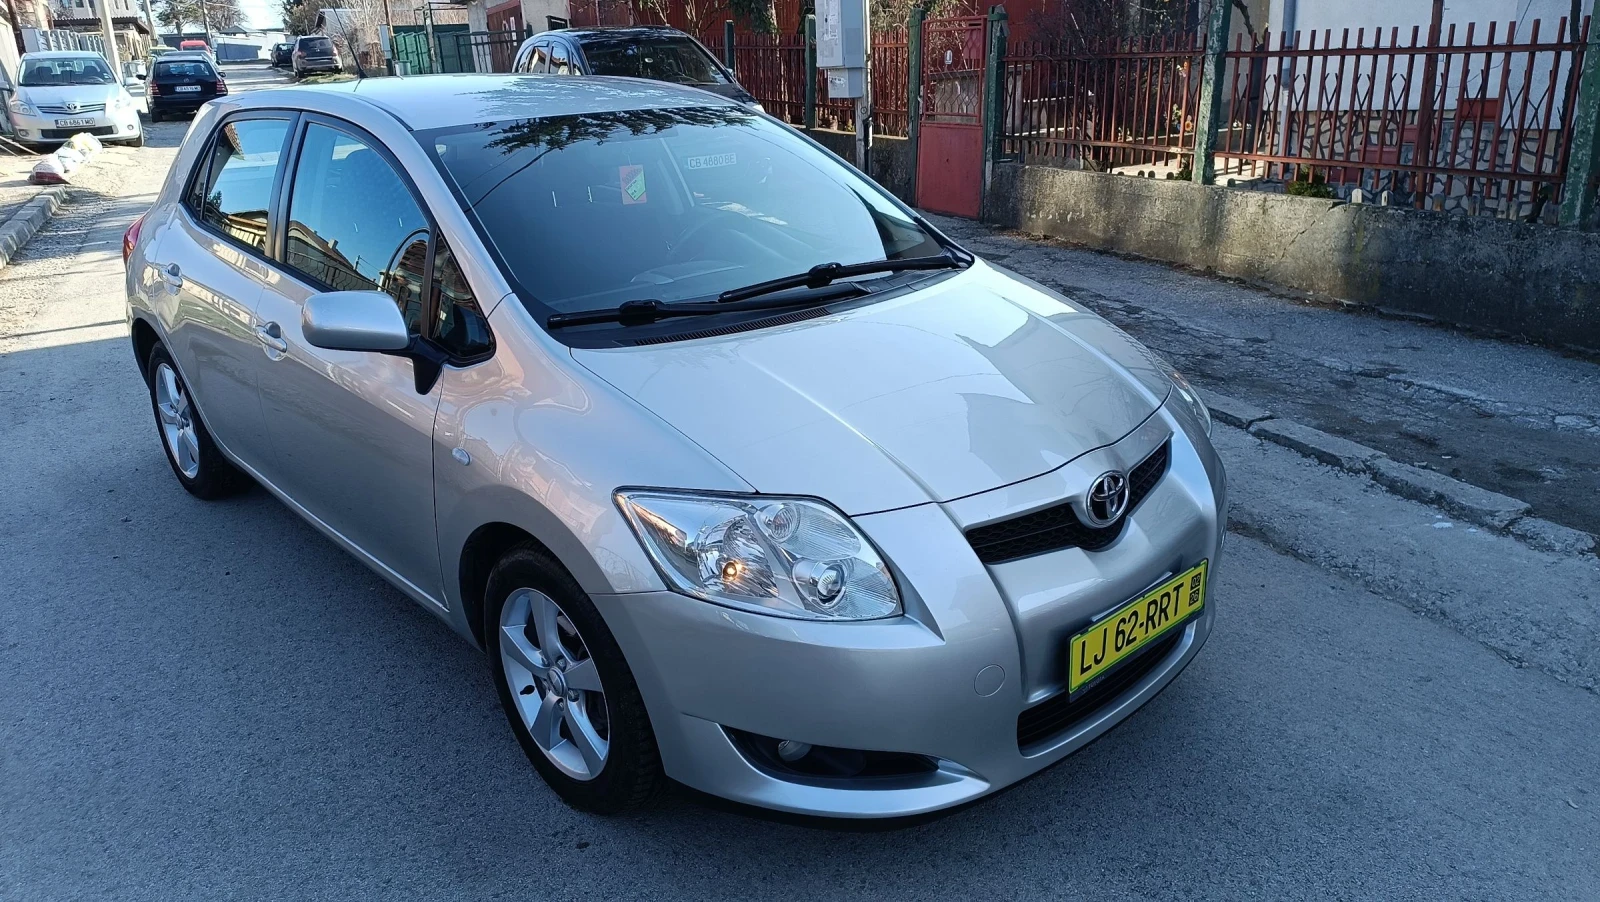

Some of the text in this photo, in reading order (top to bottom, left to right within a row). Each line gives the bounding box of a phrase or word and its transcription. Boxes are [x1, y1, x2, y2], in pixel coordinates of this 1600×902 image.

[689, 153, 735, 169] CB 4880 BE
[1191, 574, 1201, 588] 02
[1190, 590, 1199, 603] 26
[1080, 582, 1184, 676] LJ 62-RRT
